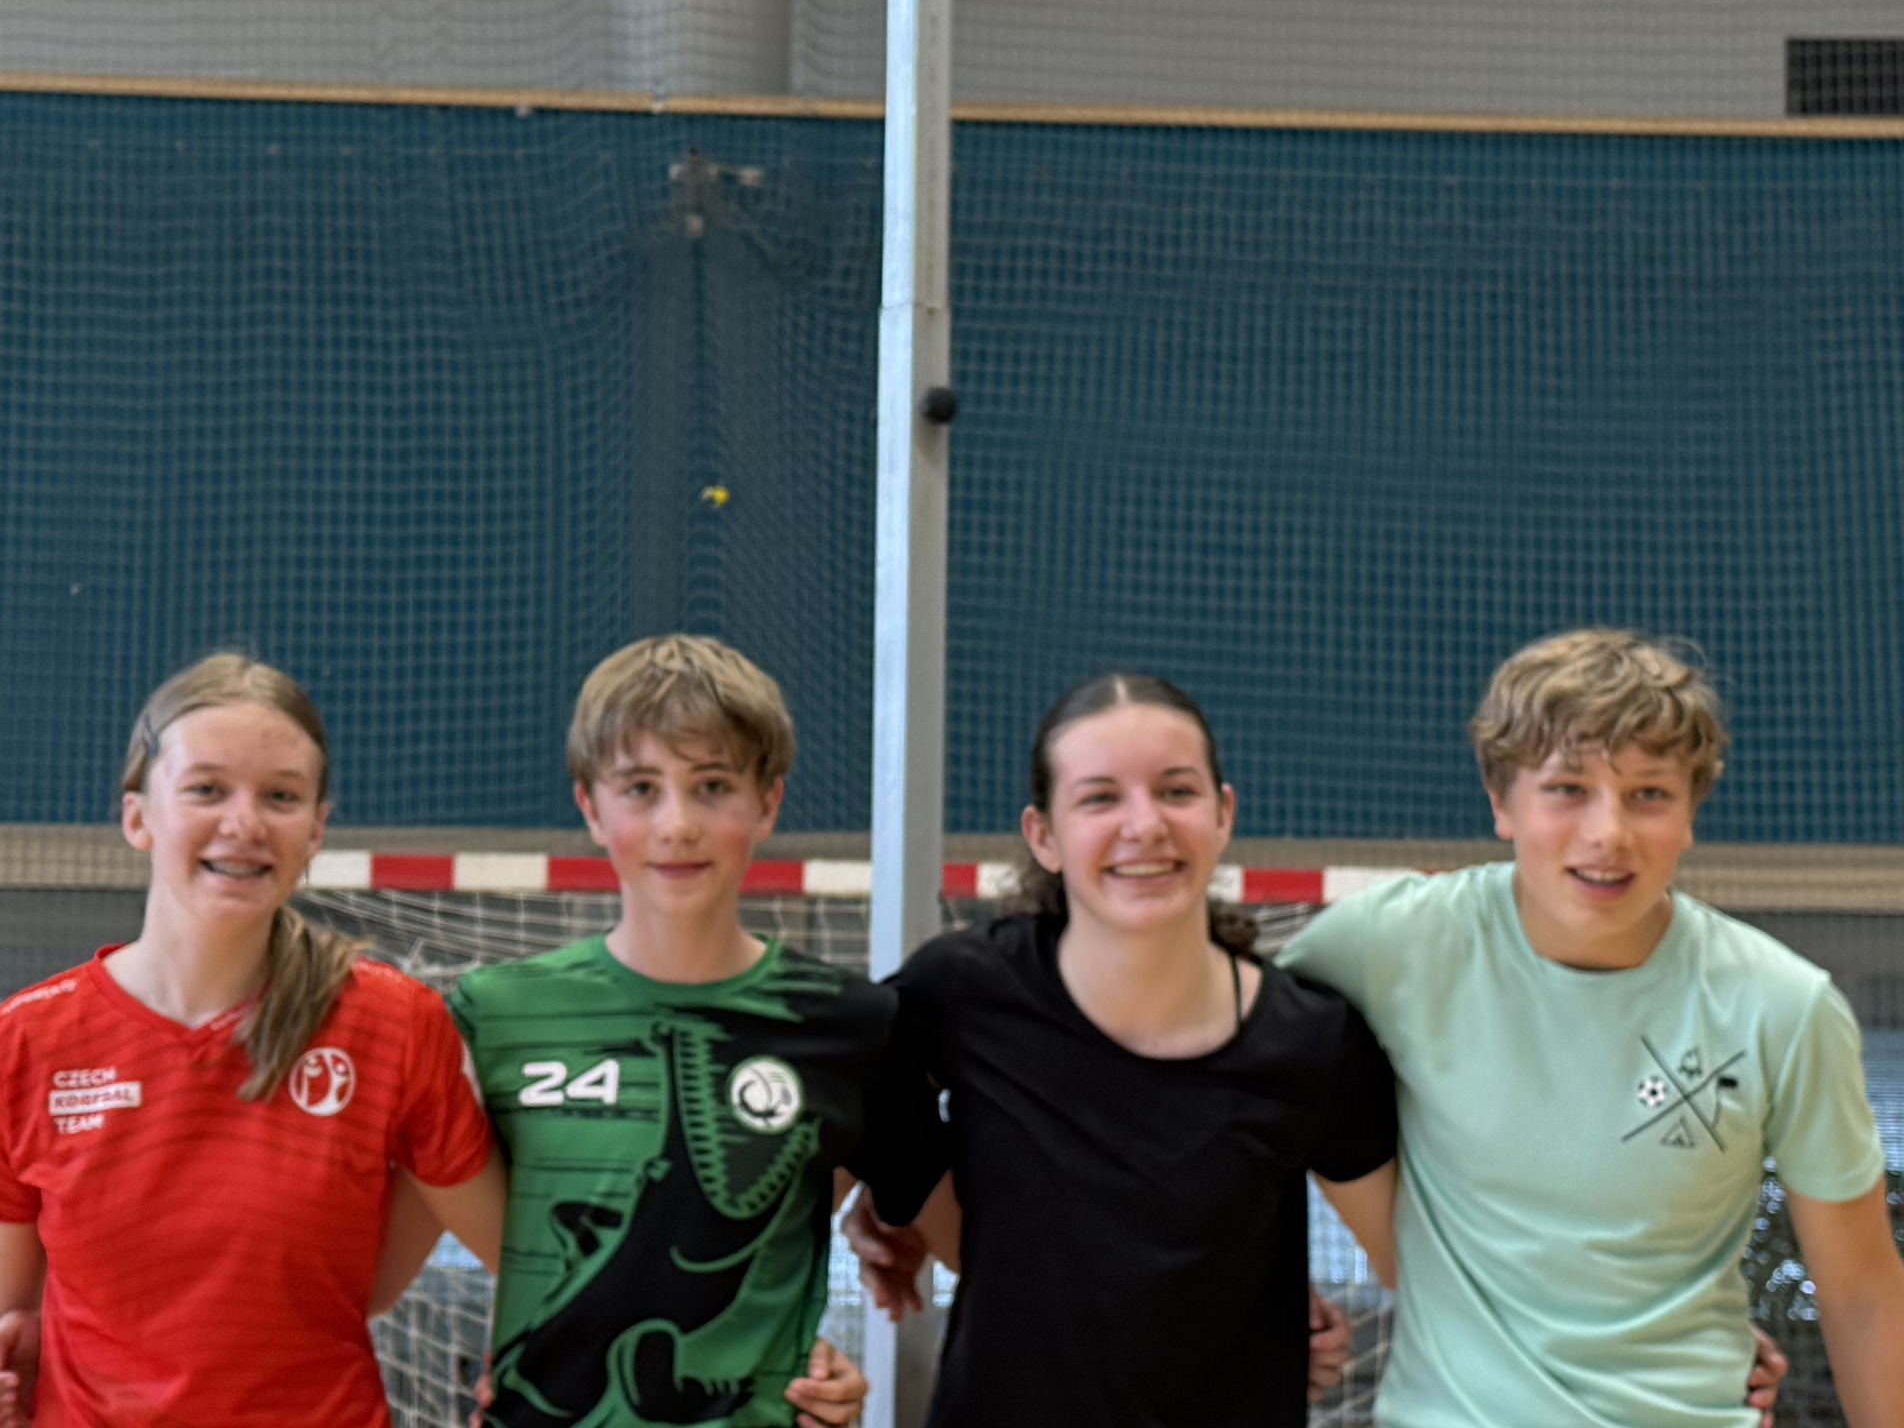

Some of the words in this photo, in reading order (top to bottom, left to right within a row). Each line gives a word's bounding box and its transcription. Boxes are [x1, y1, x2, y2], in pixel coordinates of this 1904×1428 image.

[52, 1066, 118, 1089] CZECH
[517, 1058, 621, 1108] 24
[53, 1114, 106, 1135] TEAM
